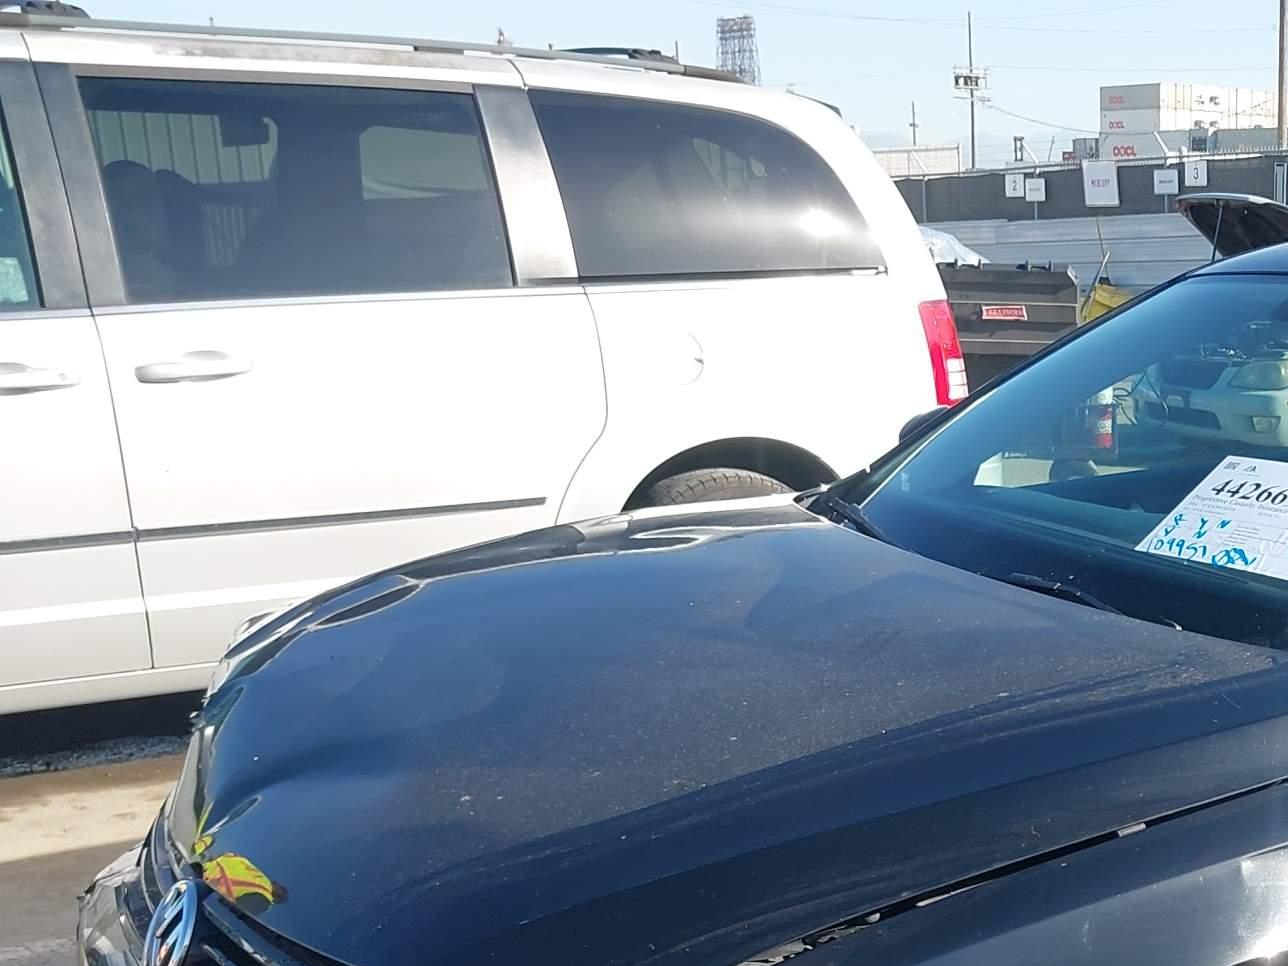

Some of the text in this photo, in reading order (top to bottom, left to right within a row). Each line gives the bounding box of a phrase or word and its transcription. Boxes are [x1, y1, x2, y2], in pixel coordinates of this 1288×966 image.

[1108, 121, 1125, 129] OOCL
[1112, 145, 1136, 157] OOCL
[1193, 167, 1199, 180] 3
[1012, 179, 1017, 191] 2
